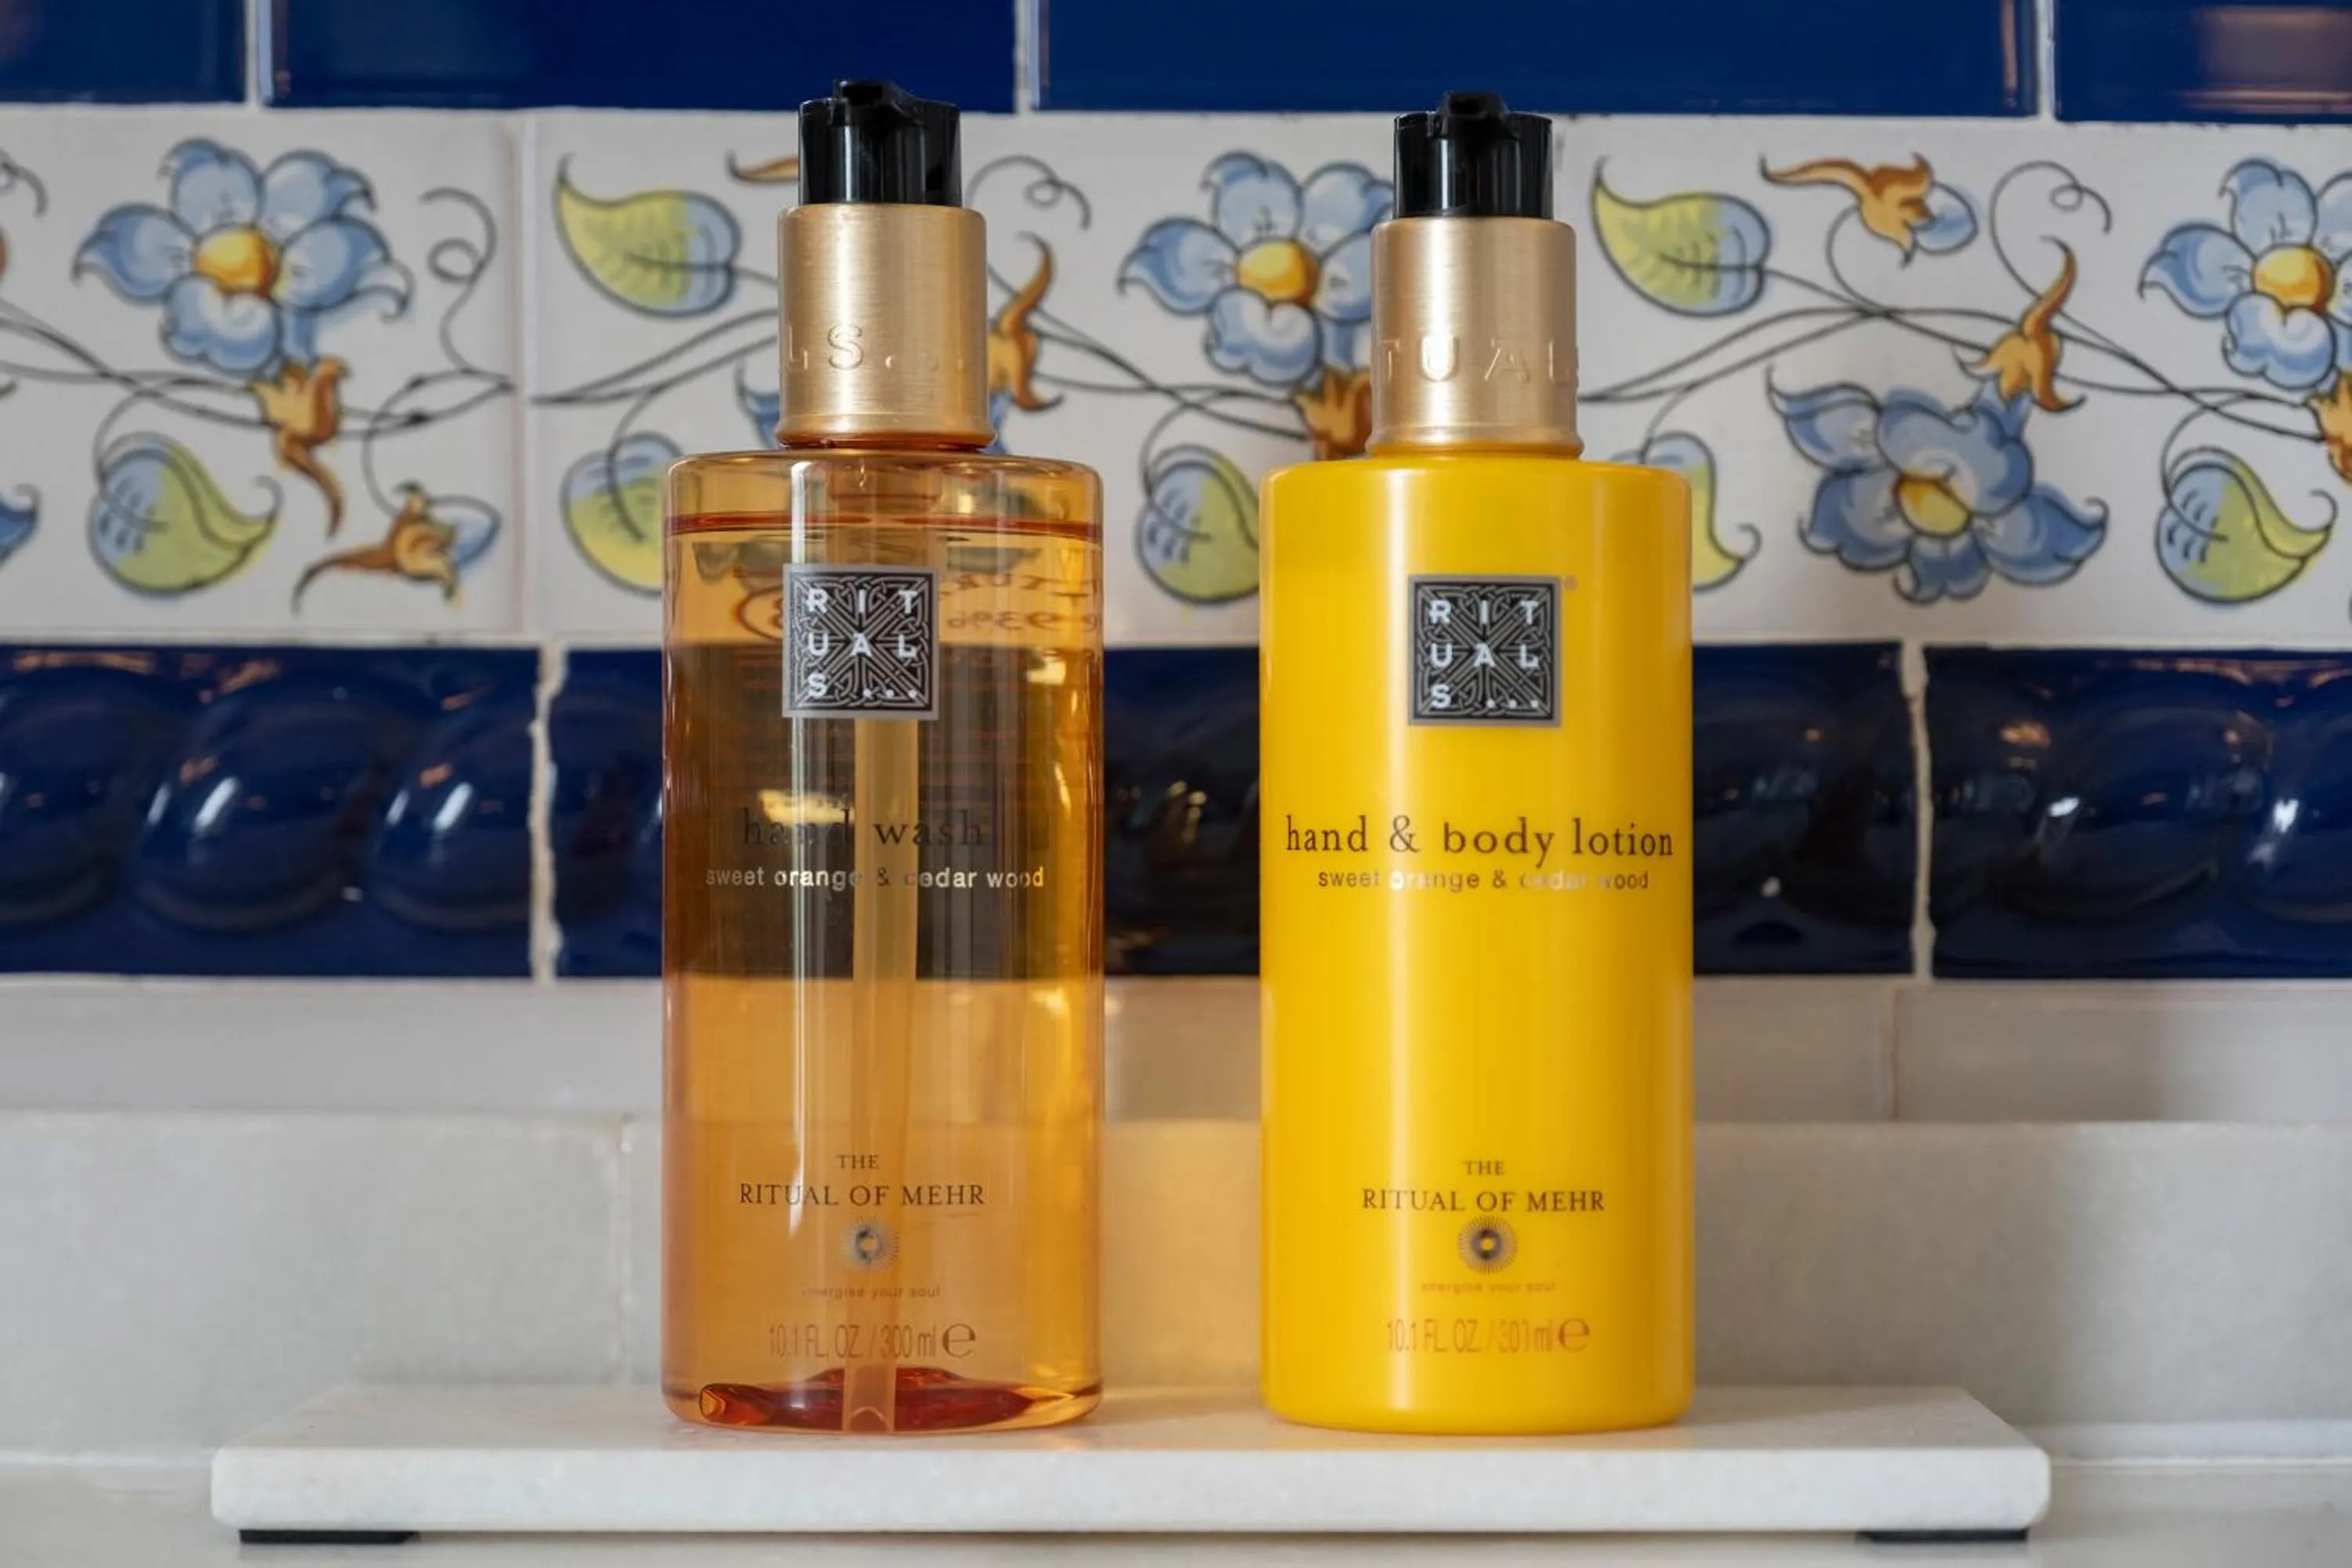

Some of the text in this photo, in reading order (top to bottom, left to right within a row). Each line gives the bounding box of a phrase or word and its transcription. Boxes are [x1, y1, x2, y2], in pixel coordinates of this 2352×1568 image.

[872, 809, 984, 847] wash
[1286, 815, 1675, 868] hand & body lotion
[704, 866, 766, 887] sweet
[877, 867, 891, 887] &
[903, 867, 978, 888] cedar
[985, 866, 1044, 888] wood
[1318, 869, 1381, 887] sweet
[1492, 868, 1508, 889] &
[838, 1154, 879, 1169] THE
[1463, 1160, 1505, 1176] THE
[739, 1182, 985, 1207] RITUAL OF MEHR
[1362, 1189, 1606, 1213] RITUAL OF MEHR
